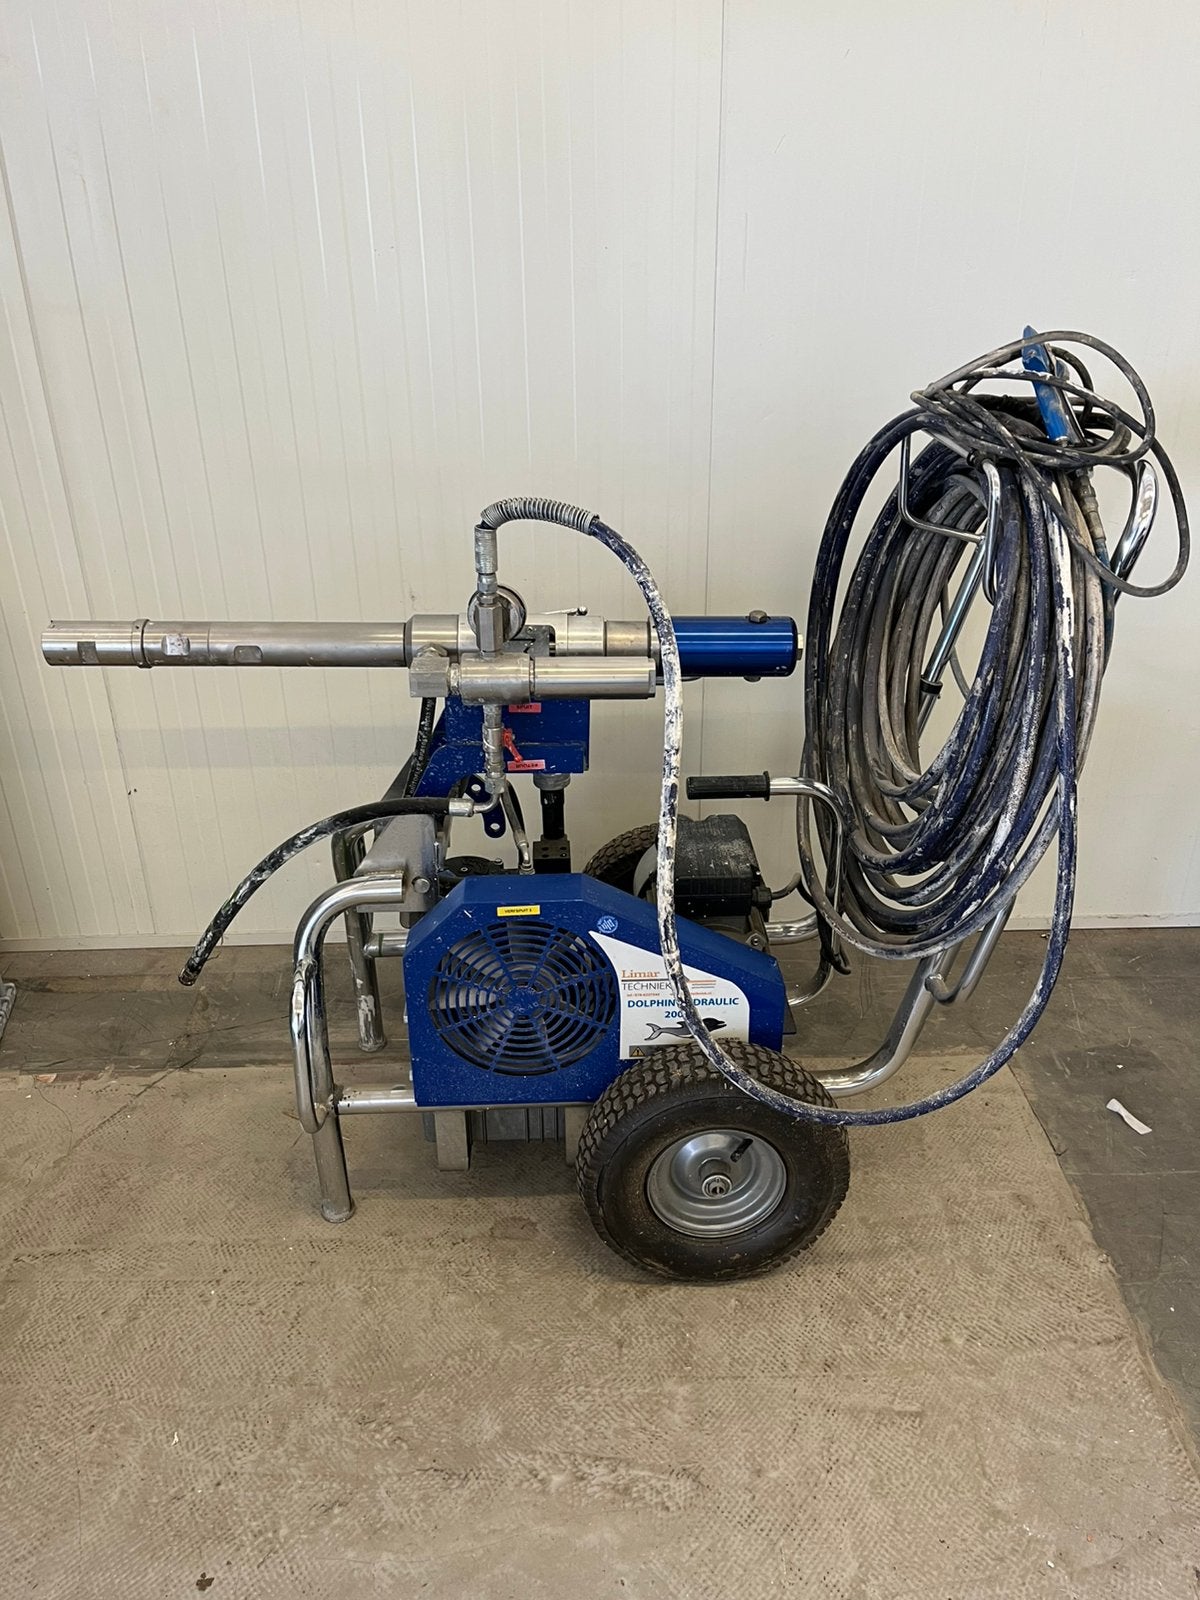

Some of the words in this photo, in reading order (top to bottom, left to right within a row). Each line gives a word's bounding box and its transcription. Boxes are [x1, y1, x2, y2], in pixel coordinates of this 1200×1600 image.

[621, 969, 661, 979] Limar
[621, 982, 672, 991] TECHNIEK
[627, 999, 676, 1008] DOLPHIN
[692, 997, 740, 1006] DRAULIC
